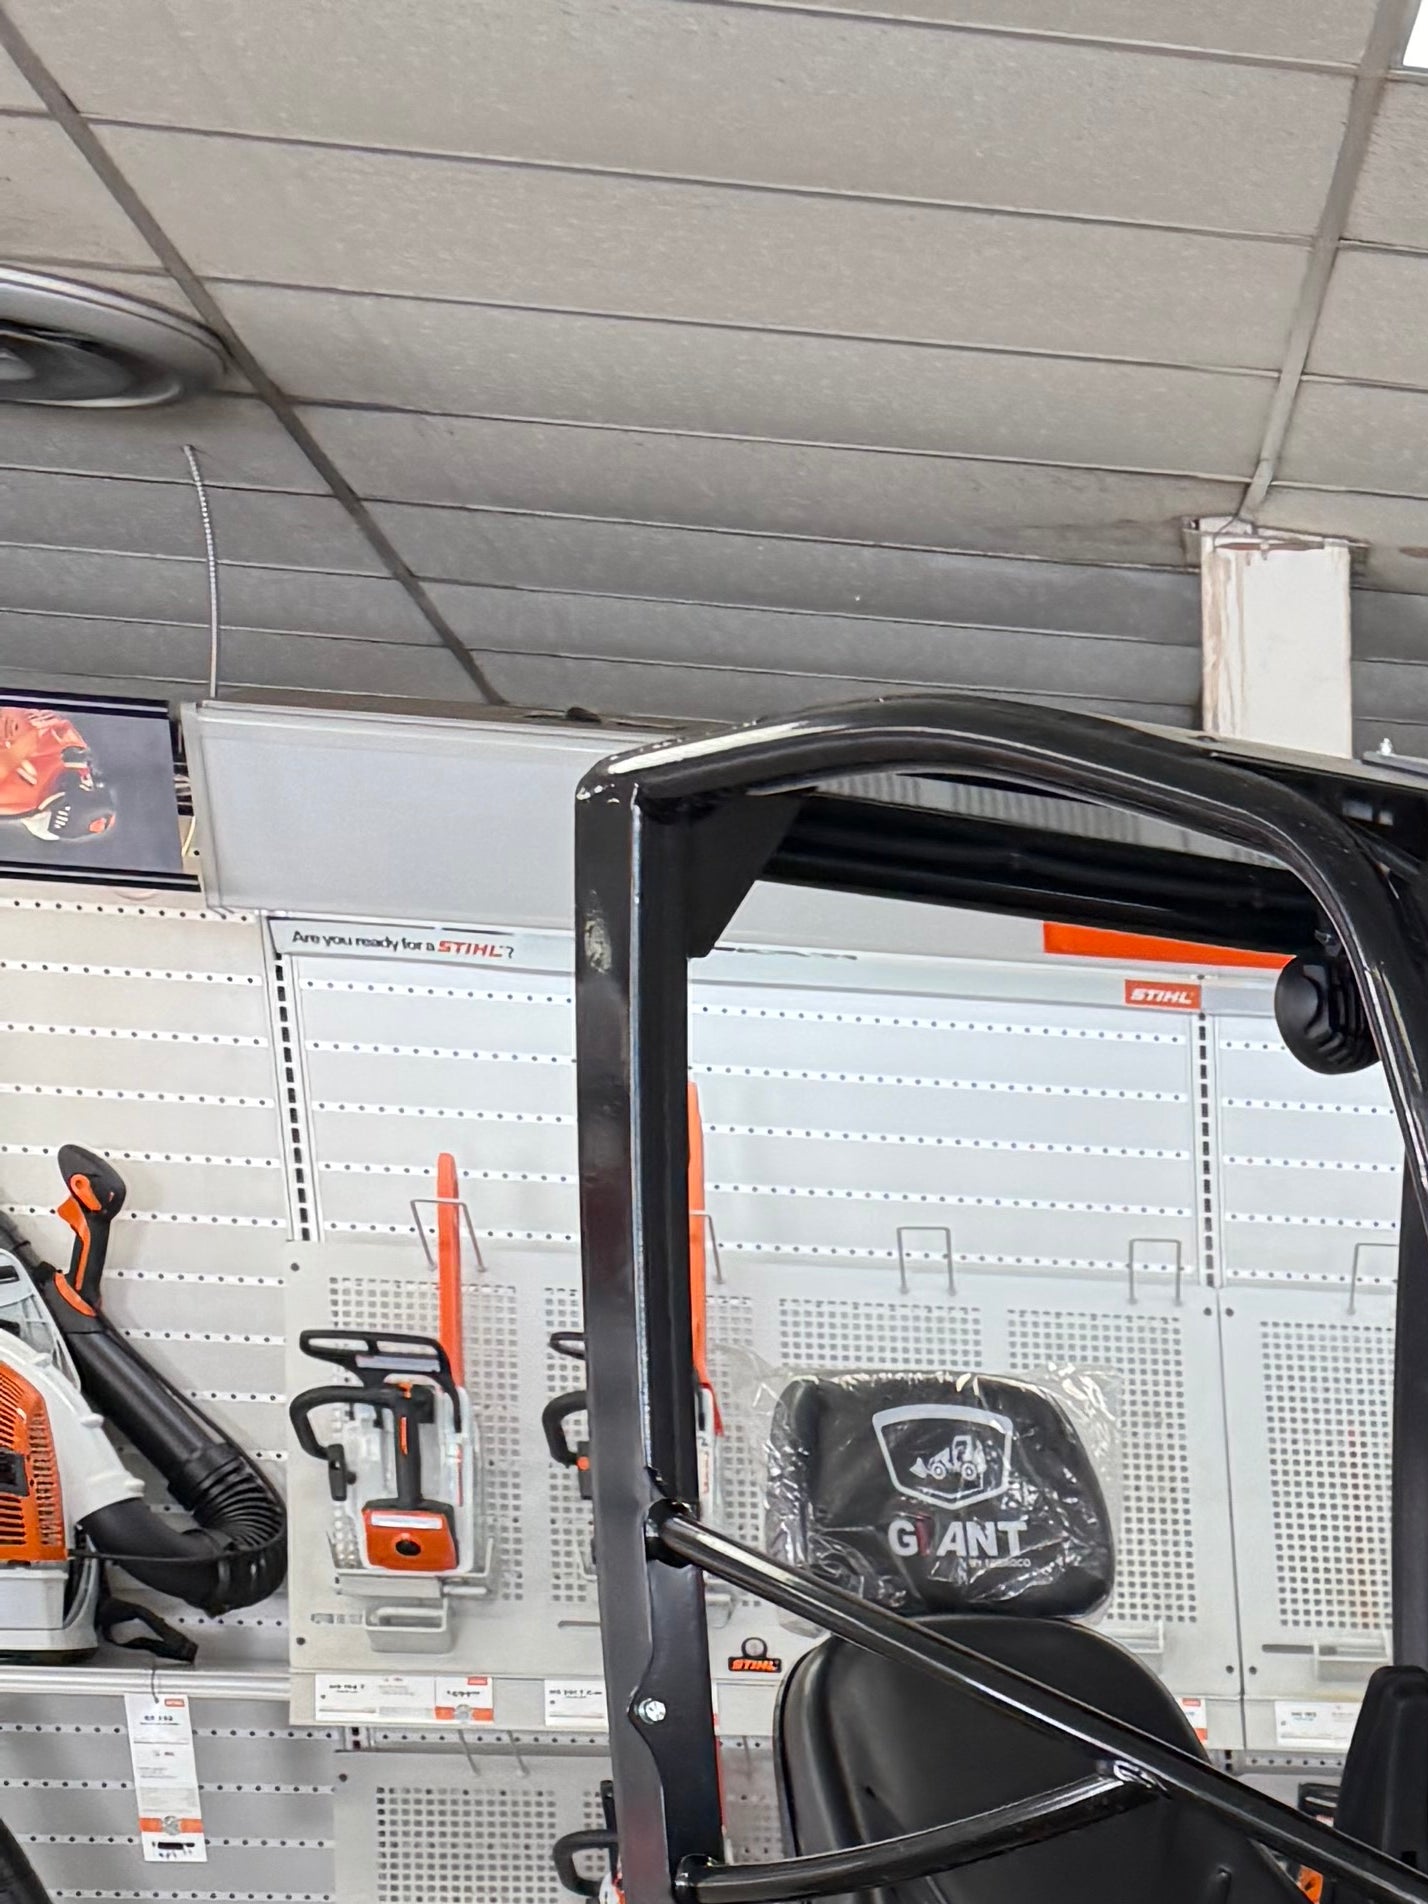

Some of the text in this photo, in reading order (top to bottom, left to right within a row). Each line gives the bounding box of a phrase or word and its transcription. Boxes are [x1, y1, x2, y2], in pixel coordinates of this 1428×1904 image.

[292, 930, 320, 944] Are
[322, 937, 351, 947] you
[355, 936, 398, 951] ready
[401, 938, 423, 950] for
[426, 942, 435, 951] a
[1130, 988, 1192, 1005] STIHL
[732, 1659, 777, 1672] STIHL
